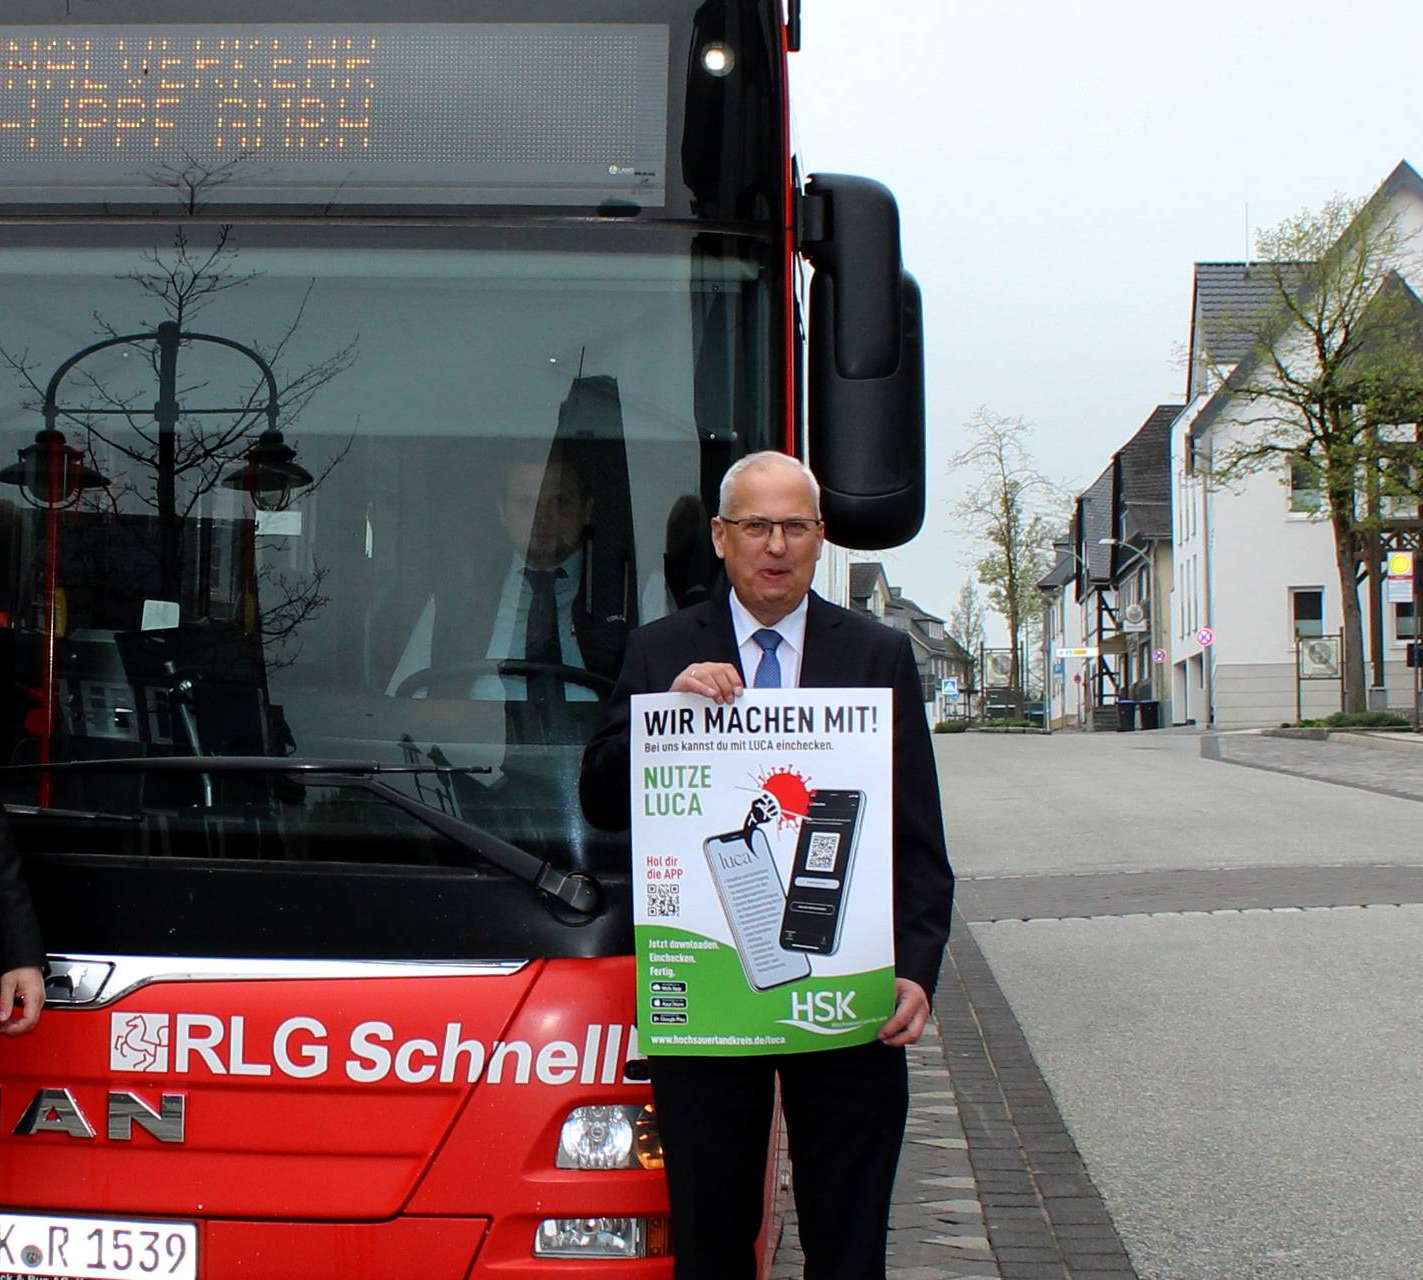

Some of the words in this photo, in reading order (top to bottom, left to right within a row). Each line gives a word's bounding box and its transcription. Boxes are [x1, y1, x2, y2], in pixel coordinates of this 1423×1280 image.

[643, 708, 695, 737] WIR
[704, 706, 815, 734] MACHEN
[824, 705, 878, 733] MIT!
[644, 742, 660, 753] Bei
[662, 743, 679, 752] uns
[681, 740, 715, 751] kannst
[716, 740, 729, 751] du
[730, 740, 747, 751] mit
[748, 740, 774, 751] LUCA
[776, 740, 835, 751] einchecken.
[643, 765, 712, 789] NUTZE
[644, 792, 703, 816] LUCA
[646, 856, 663, 867] Hol
[665, 856, 679, 867] dir
[718, 852, 752, 870] luca
[646, 868, 662, 880] die
[664, 868, 684, 880] APP
[648, 939, 669, 949] Jetzt
[669, 940, 720, 950] downloaden.
[649, 952, 697, 963] Einchecken.
[649, 966, 676, 978] Fertig.
[791, 990, 857, 1022] HSK
[175, 1012, 329, 1079] RLG
[48, 1225, 69, 1268] R
[86, 1228, 187, 1274] 1539
